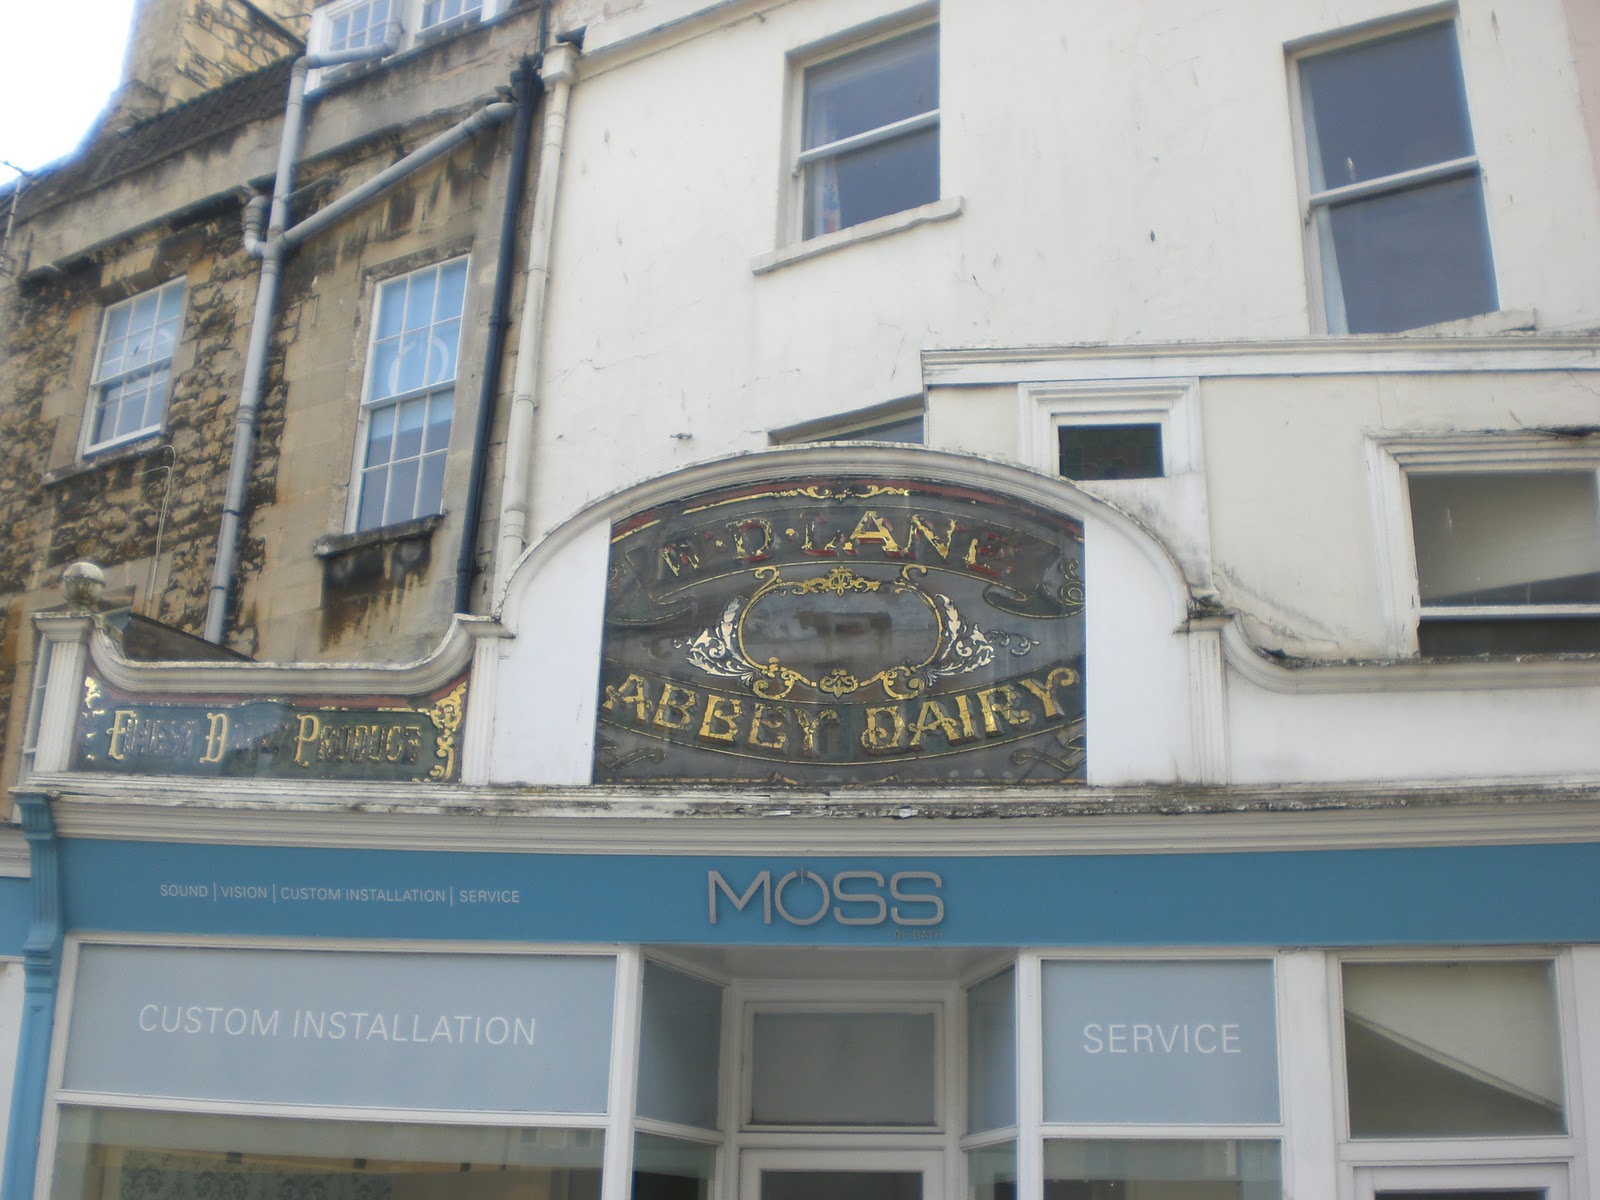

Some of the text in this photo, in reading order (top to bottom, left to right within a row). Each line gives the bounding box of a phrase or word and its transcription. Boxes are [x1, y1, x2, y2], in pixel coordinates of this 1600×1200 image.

[603, 667, 1080, 757] ABBEY DAIRY
[160, 884, 521, 903] SOUND VISION CUSTOM INSTALLATION SERVICE
[707, 868, 945, 926] MOSS
[138, 1004, 537, 1047] CUSTOM INSTALLATION
[1083, 1023, 1241, 1054] SERVICE
